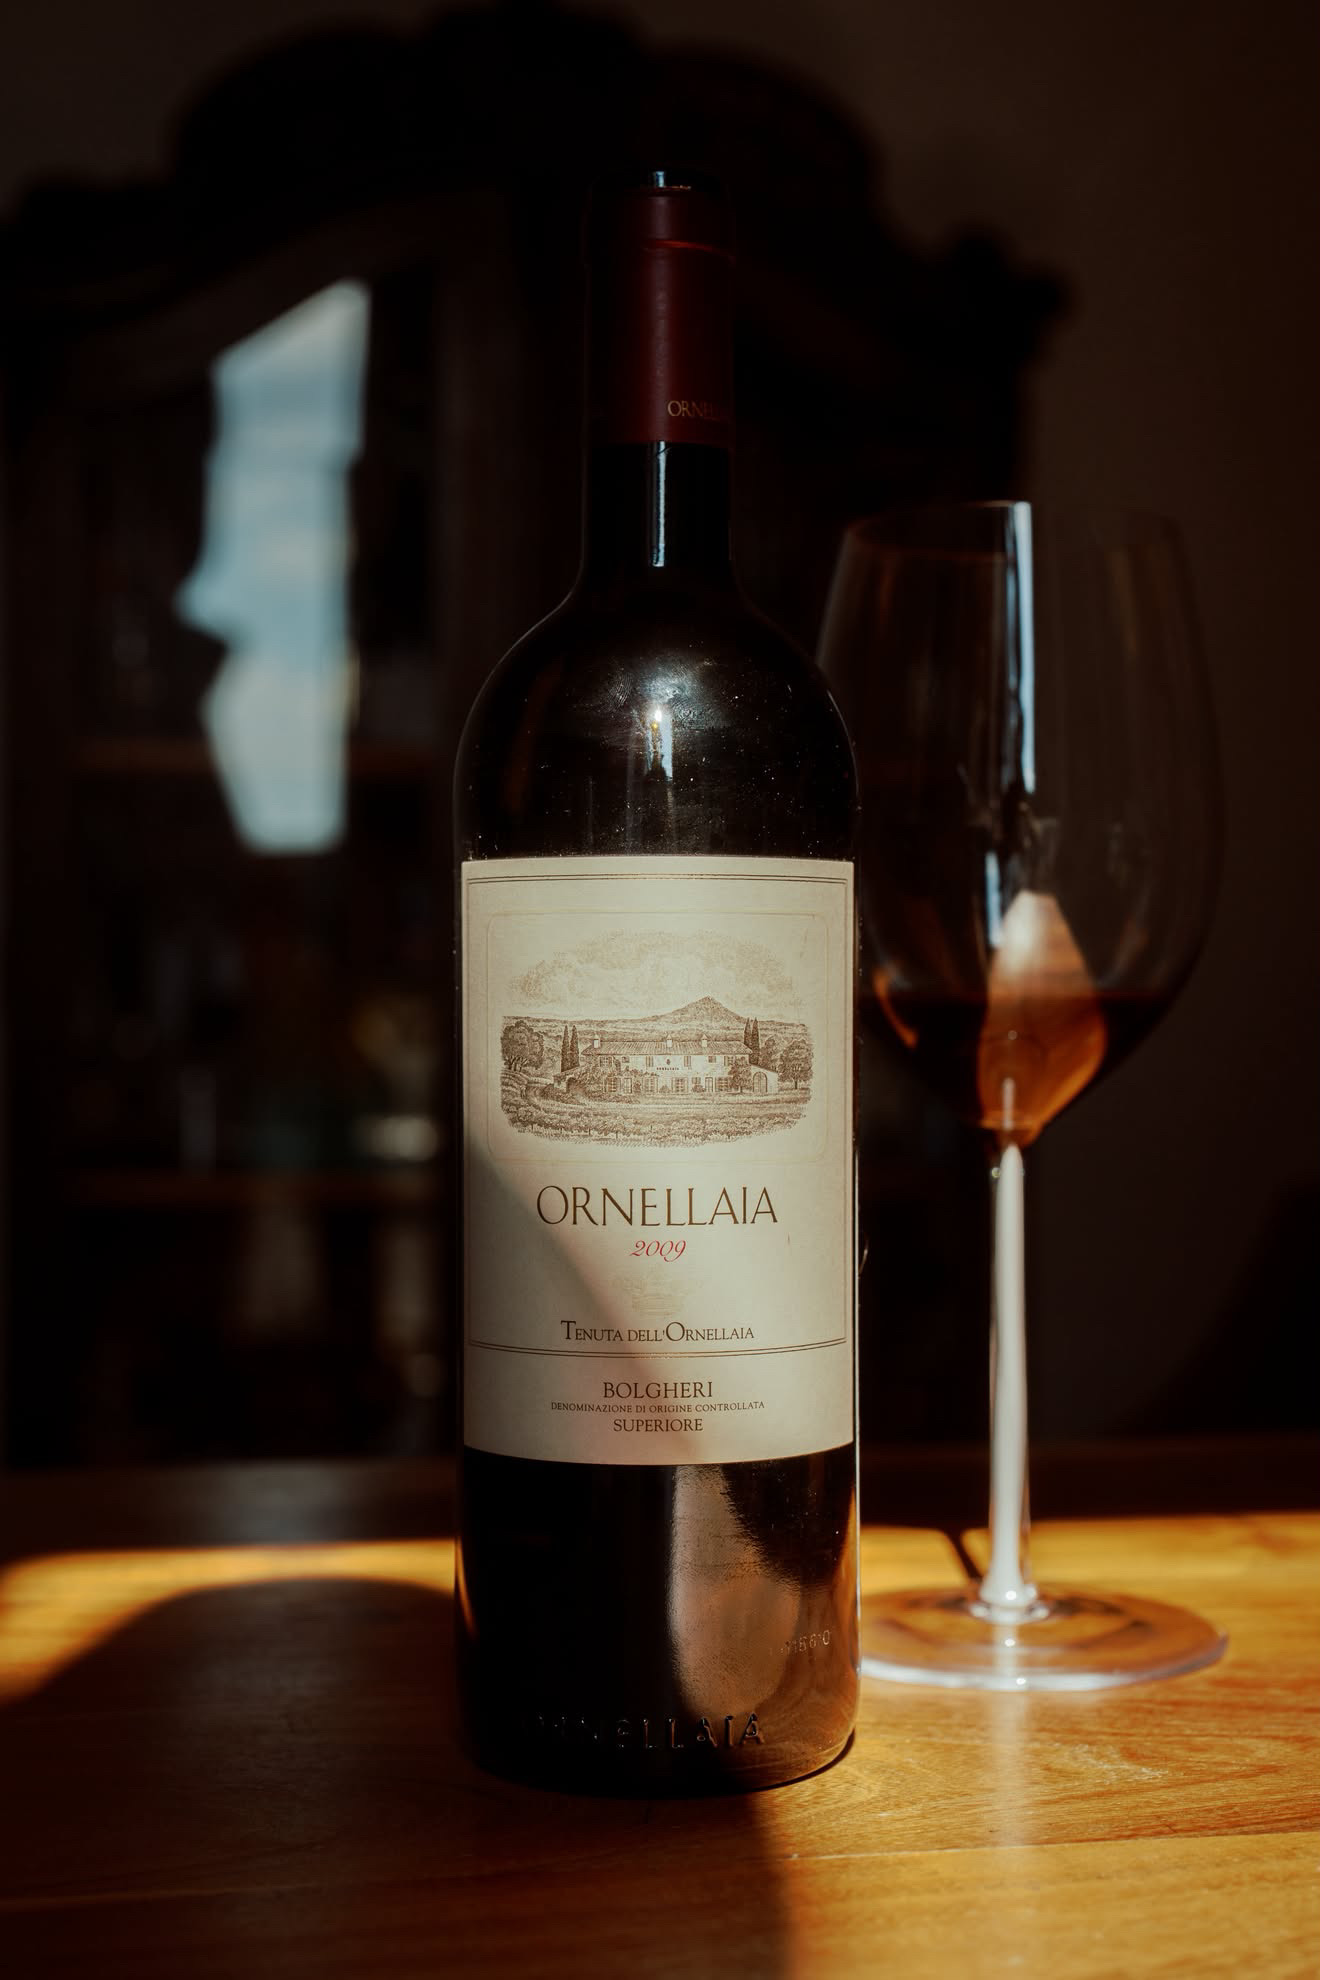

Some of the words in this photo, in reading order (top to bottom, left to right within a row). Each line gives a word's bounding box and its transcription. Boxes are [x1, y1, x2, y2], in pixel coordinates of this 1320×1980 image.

[537, 1185, 778, 1227] ORNELLAIA
[629, 1239, 687, 1263] 2009
[603, 1381, 713, 1400] BOLGHERI
[551, 1402, 633, 1413] DENOMINAZIONE
[636, 1404, 646, 1413] DI
[649, 1404, 692, 1413] ORIGINE
[695, 1401, 765, 1413] CONTROLLATA
[613, 1418, 704, 1433] SUPERIORE
